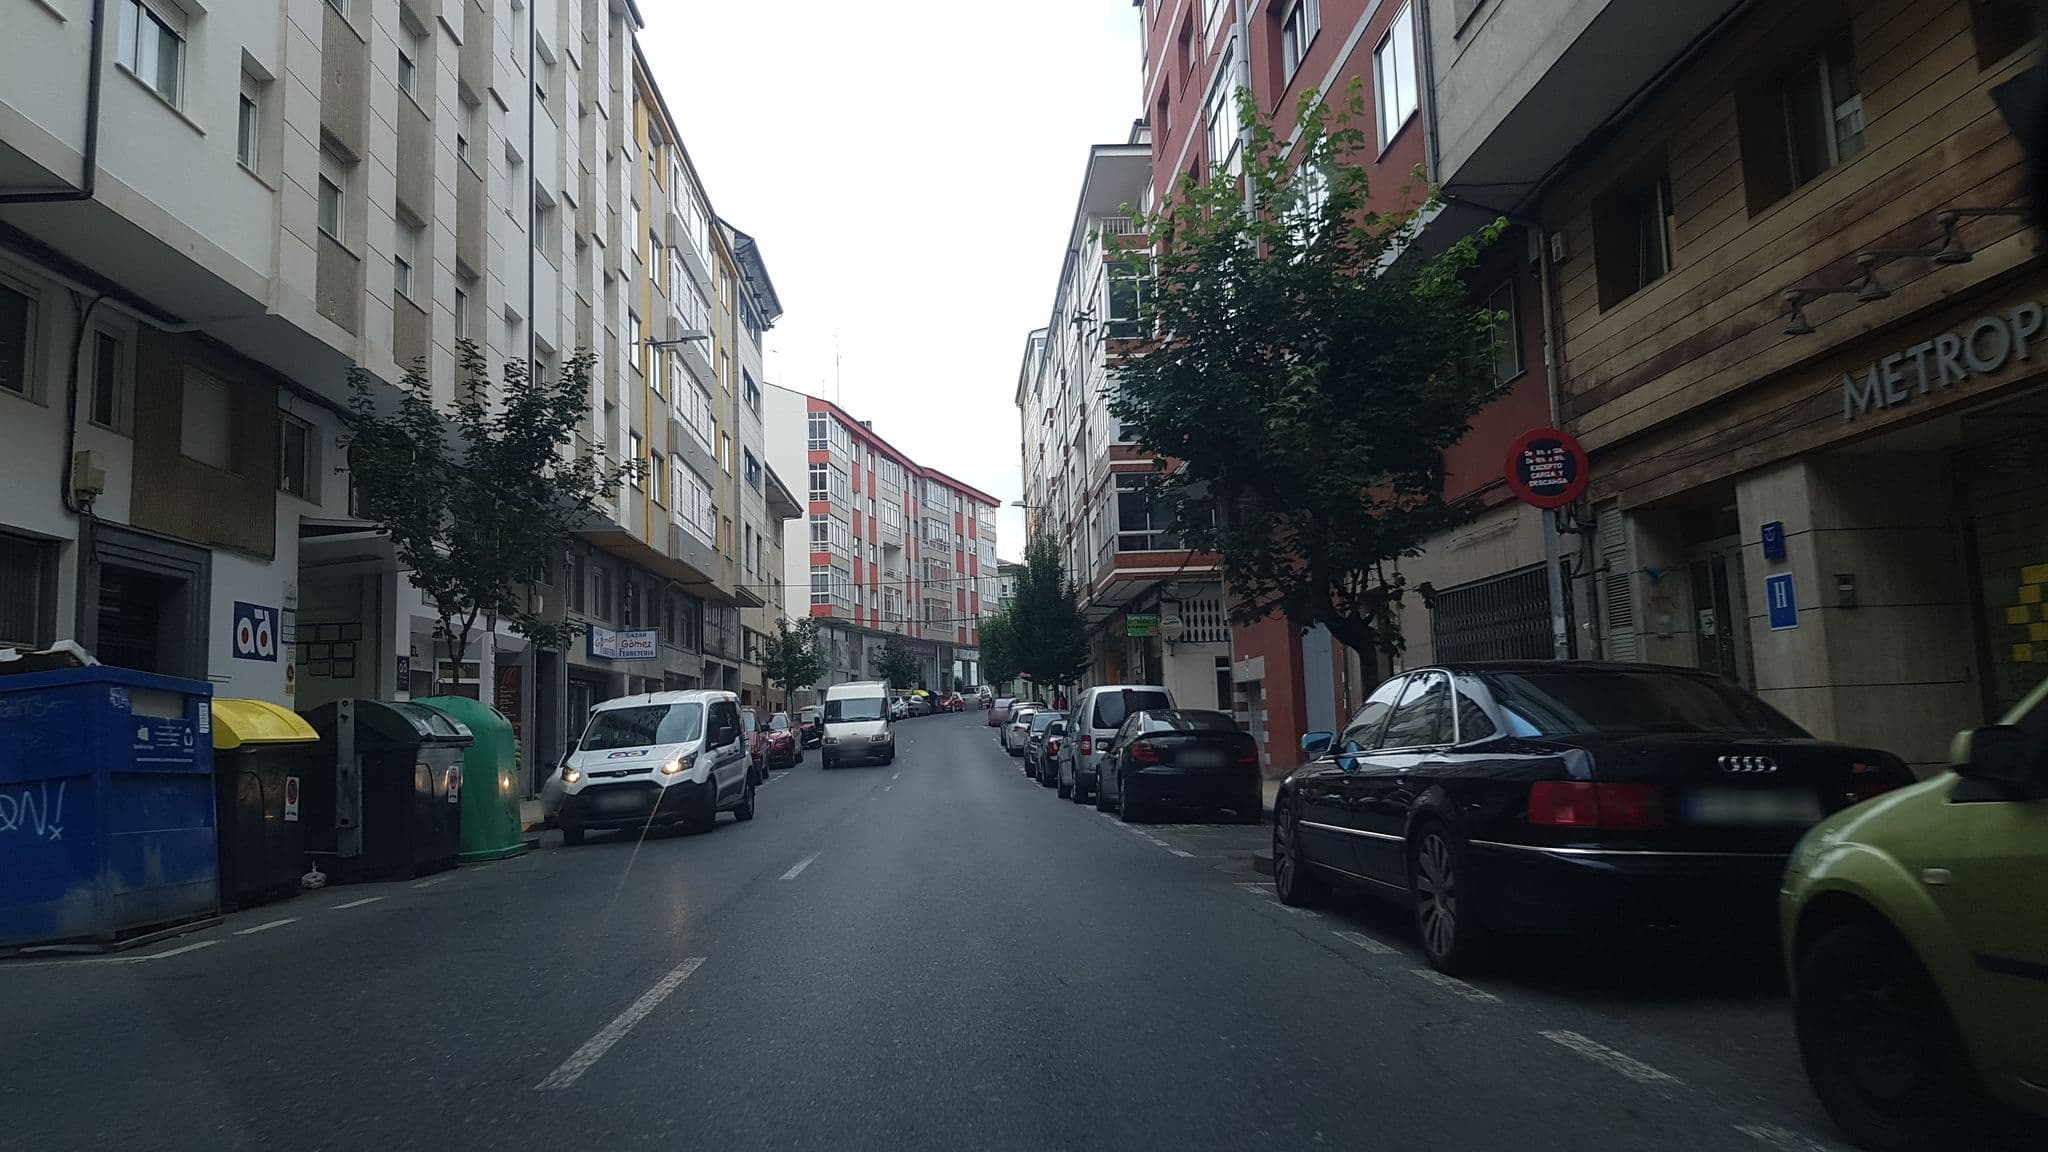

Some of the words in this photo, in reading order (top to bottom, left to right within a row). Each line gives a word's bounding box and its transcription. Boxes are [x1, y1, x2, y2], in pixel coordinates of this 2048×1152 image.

[1530, 463, 1562, 471] EXCEPTO
[1530, 471, 1556, 479] CARGA
[1528, 477, 1568, 487] DESCARGA
